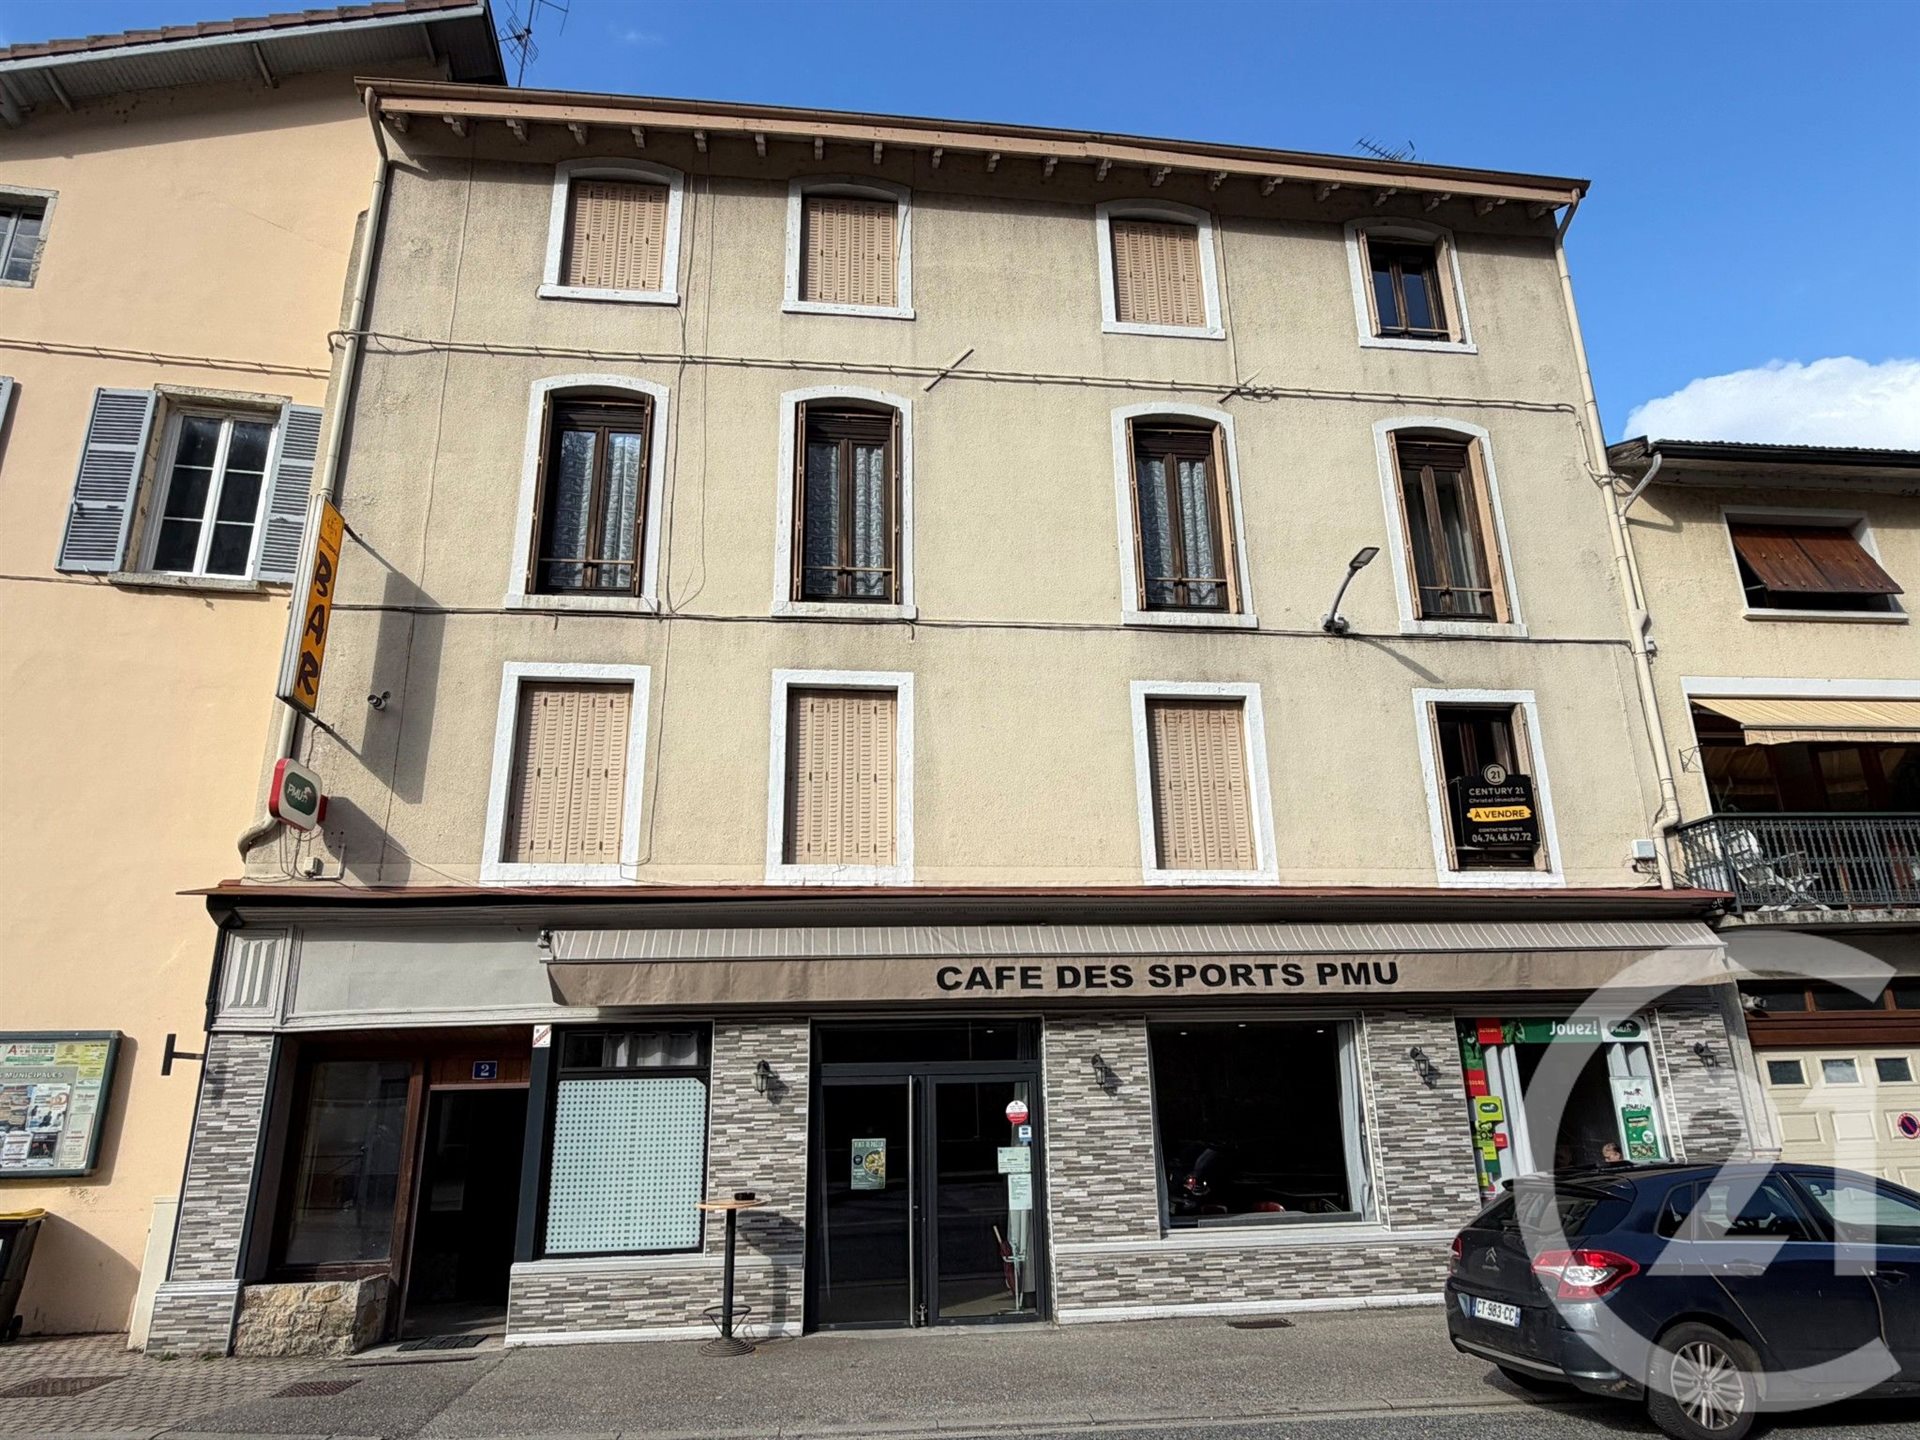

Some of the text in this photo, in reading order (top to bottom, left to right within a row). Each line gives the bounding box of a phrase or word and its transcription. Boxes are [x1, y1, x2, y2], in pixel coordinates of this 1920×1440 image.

[297, 550, 332, 696] BAR
[1490, 771, 1501, 779] 21
[1468, 786, 1525, 796] CENTURY 21
[1484, 809, 1526, 819] VENDRE
[1471, 832, 1532, 842] 04.74.48.47.72
[936, 961, 1399, 990] CAFE DES SPORTS PMU
[1549, 1020, 1598, 1036] Jouez!
[480, 1064, 490, 1076] 2
[1477, 1300, 1515, 1321] CT-983-CC
